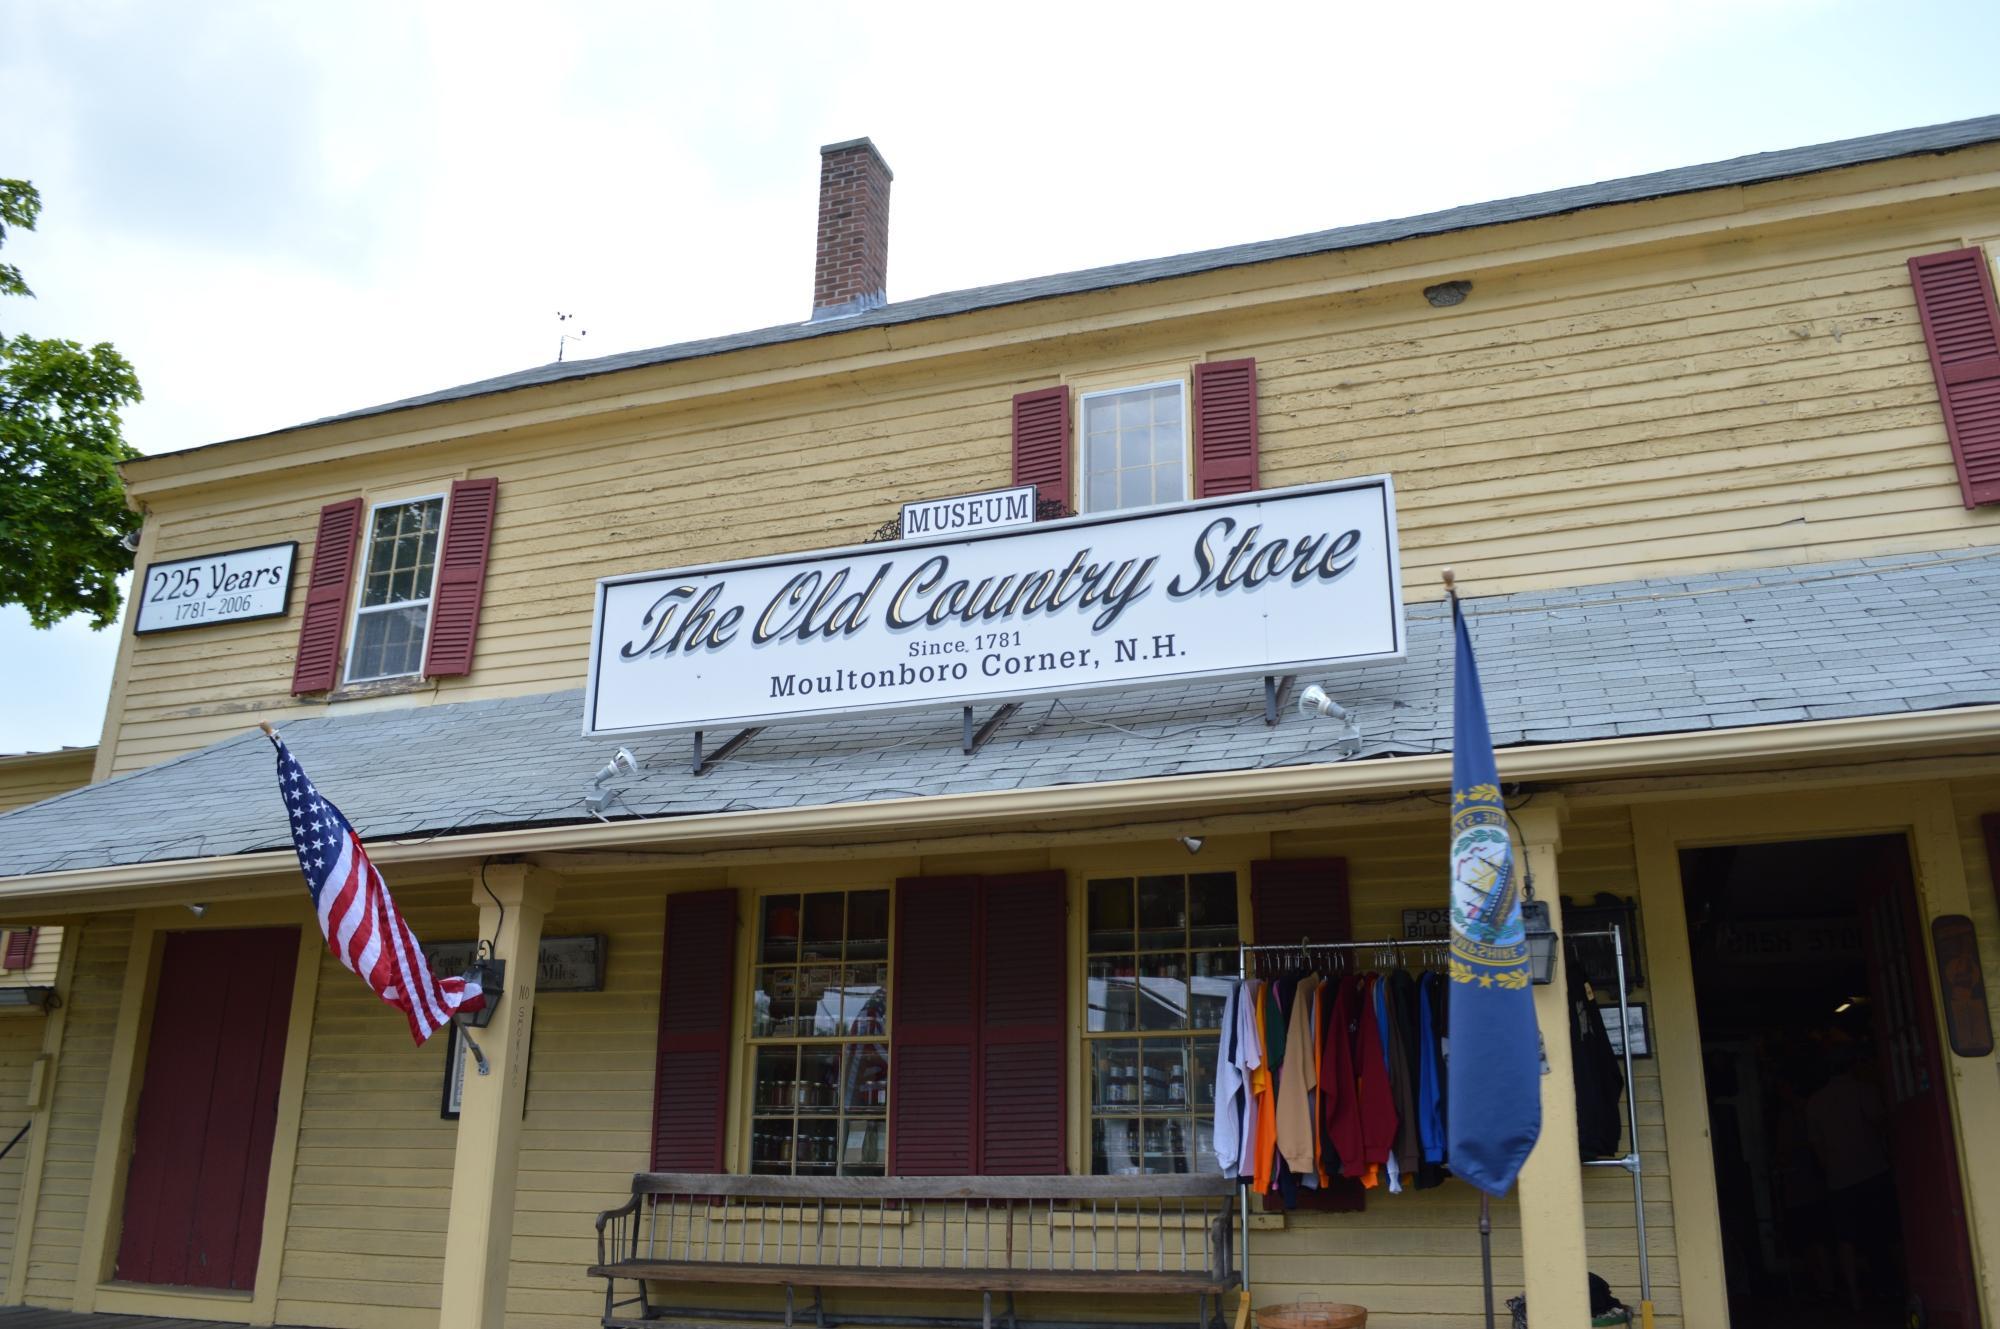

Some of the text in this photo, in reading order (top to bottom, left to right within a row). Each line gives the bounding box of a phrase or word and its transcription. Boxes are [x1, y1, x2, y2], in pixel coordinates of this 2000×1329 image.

[907, 494, 1028, 533] MUSEUM
[150, 562, 283, 603] 225 Years
[620, 517, 1361, 659] The Old Country Store
[975, 631, 1021, 650] 1781
[769, 633, 1186, 698] Moultonboro Corner, N.H.
[1408, 924, 1450, 938] BILL
[519, 983, 530, 1001] NO
